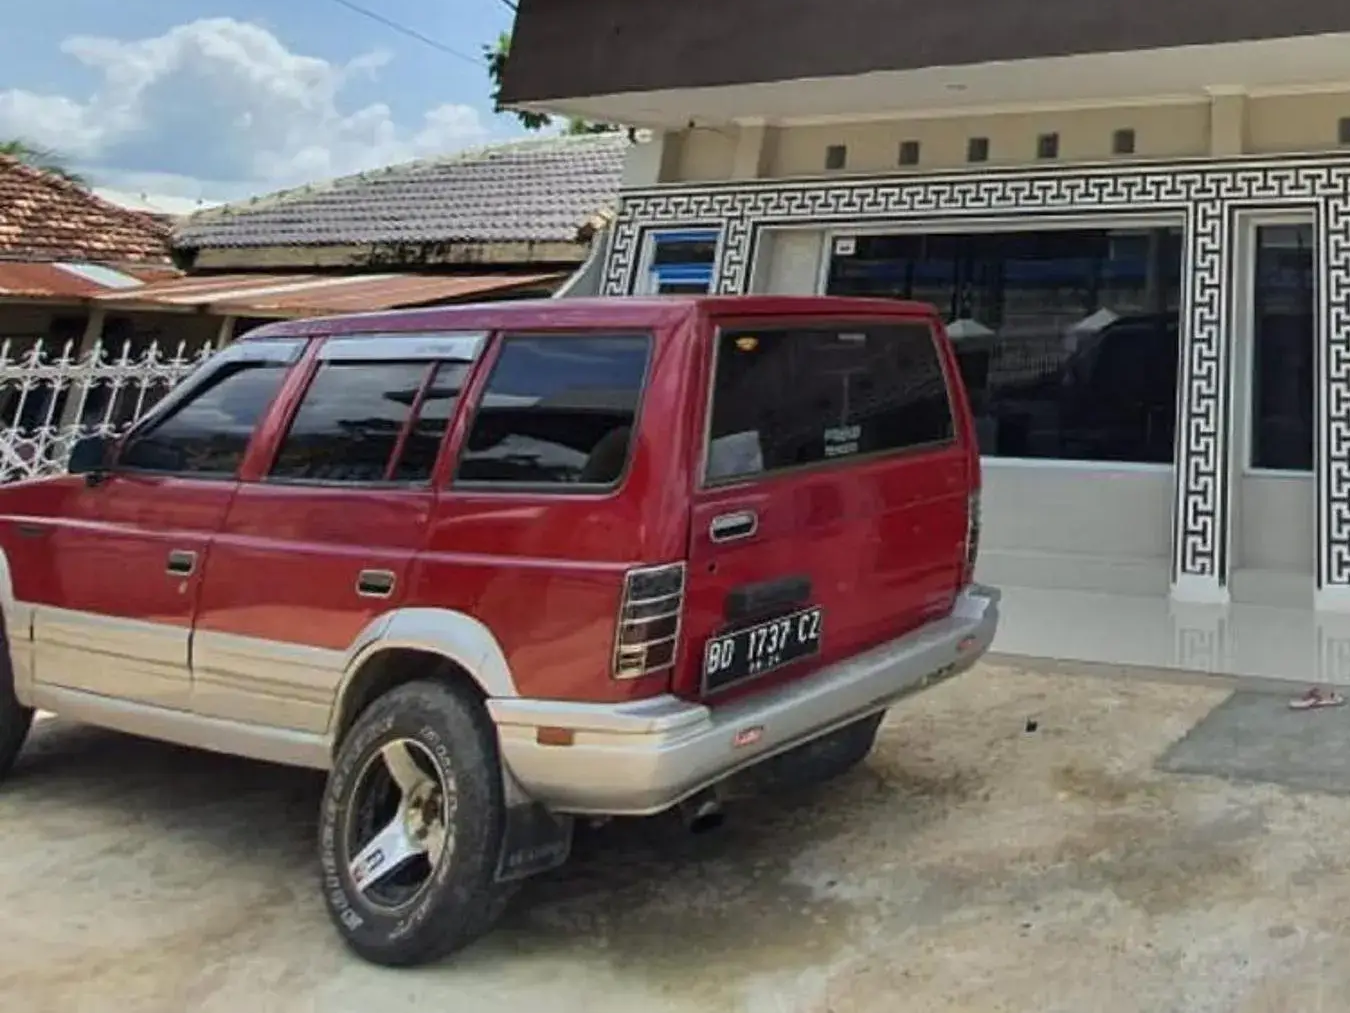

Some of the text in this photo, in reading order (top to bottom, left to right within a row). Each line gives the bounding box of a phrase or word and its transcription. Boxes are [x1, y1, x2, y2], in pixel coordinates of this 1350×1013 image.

[707, 639, 735, 674] BD
[748, 620, 791, 659] 1737
[798, 611, 820, 642] CZ
